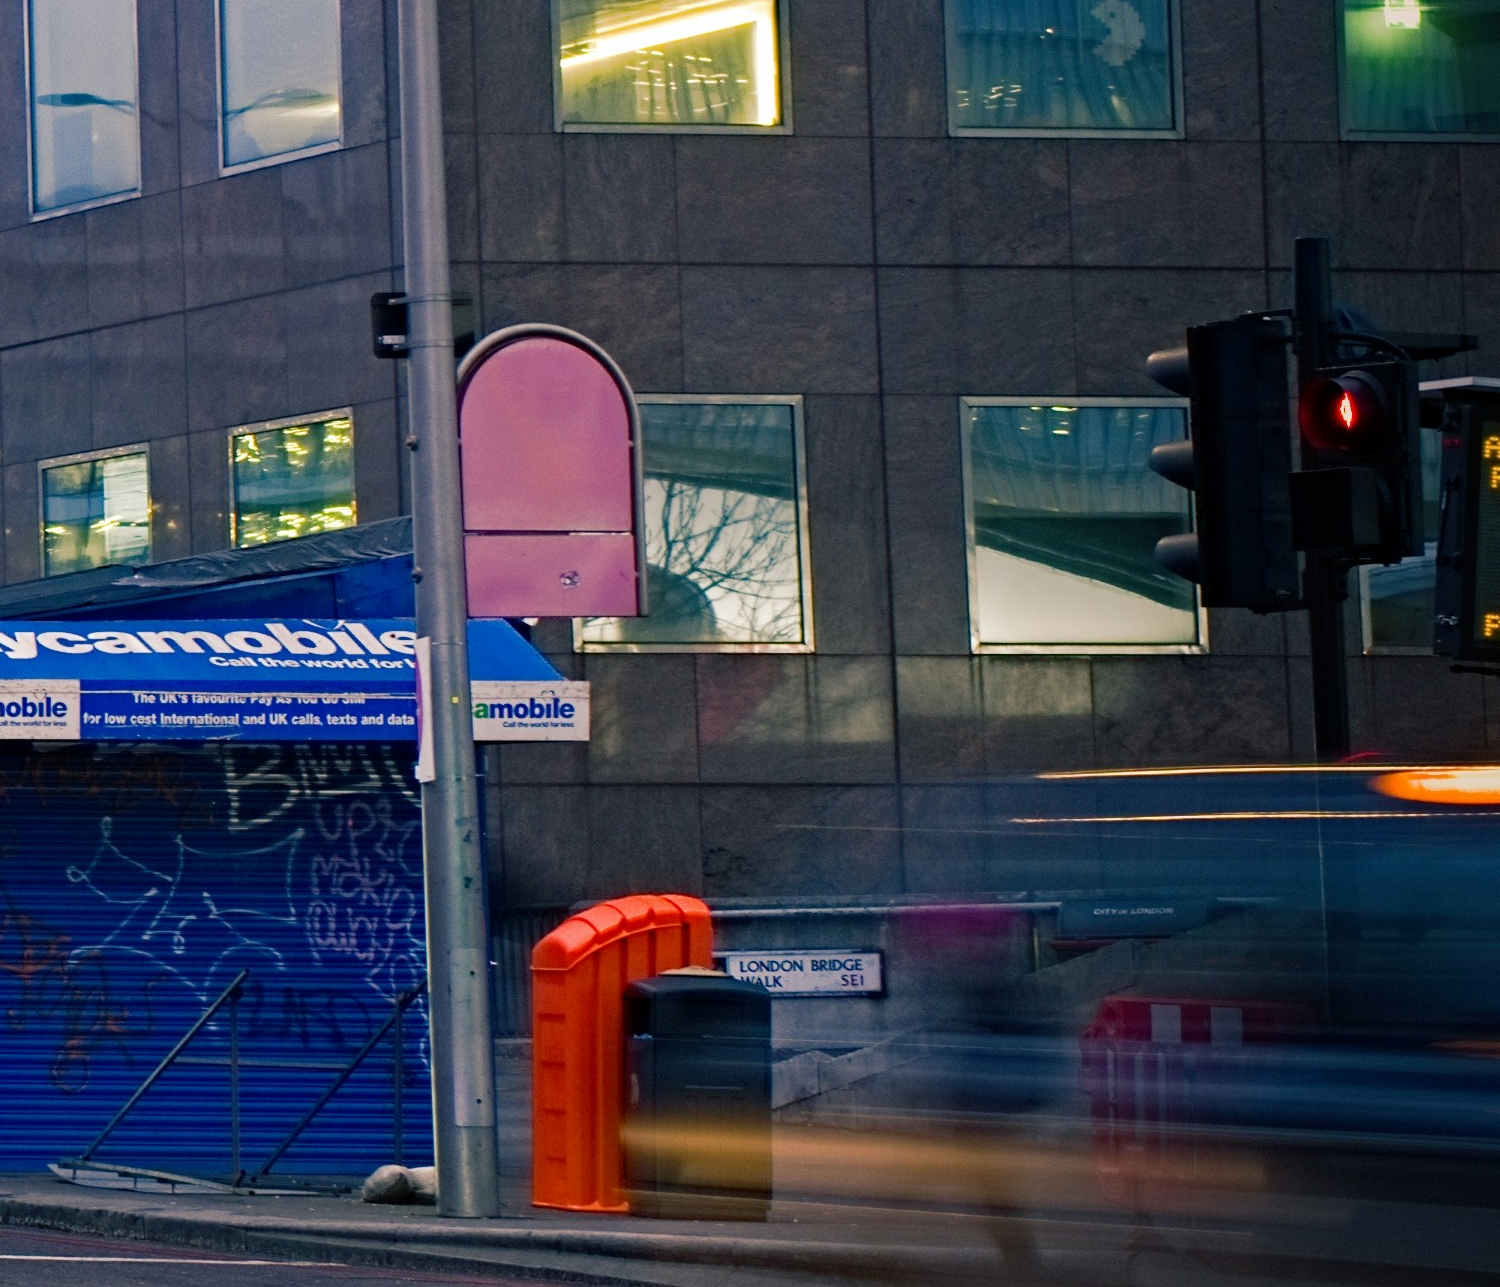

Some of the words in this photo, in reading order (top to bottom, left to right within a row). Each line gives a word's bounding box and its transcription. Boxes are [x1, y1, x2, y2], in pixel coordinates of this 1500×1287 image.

[209, 656, 258, 668] Call
[261, 656, 299, 669] the
[300, 657, 368, 669] world
[369, 657, 402, 669] for
[104, 712, 127, 725] low
[160, 713, 240, 726] International
[242, 713, 266, 725] and
[269, 713, 288, 725] UK
[326, 714, 358, 725] texts
[361, 713, 384, 725] and
[387, 713, 415, 725] data
[1130, 907, 1175, 915] LONDON
[739, 959, 804, 973] LONDON
[811, 958, 864, 972] BRIDGE
